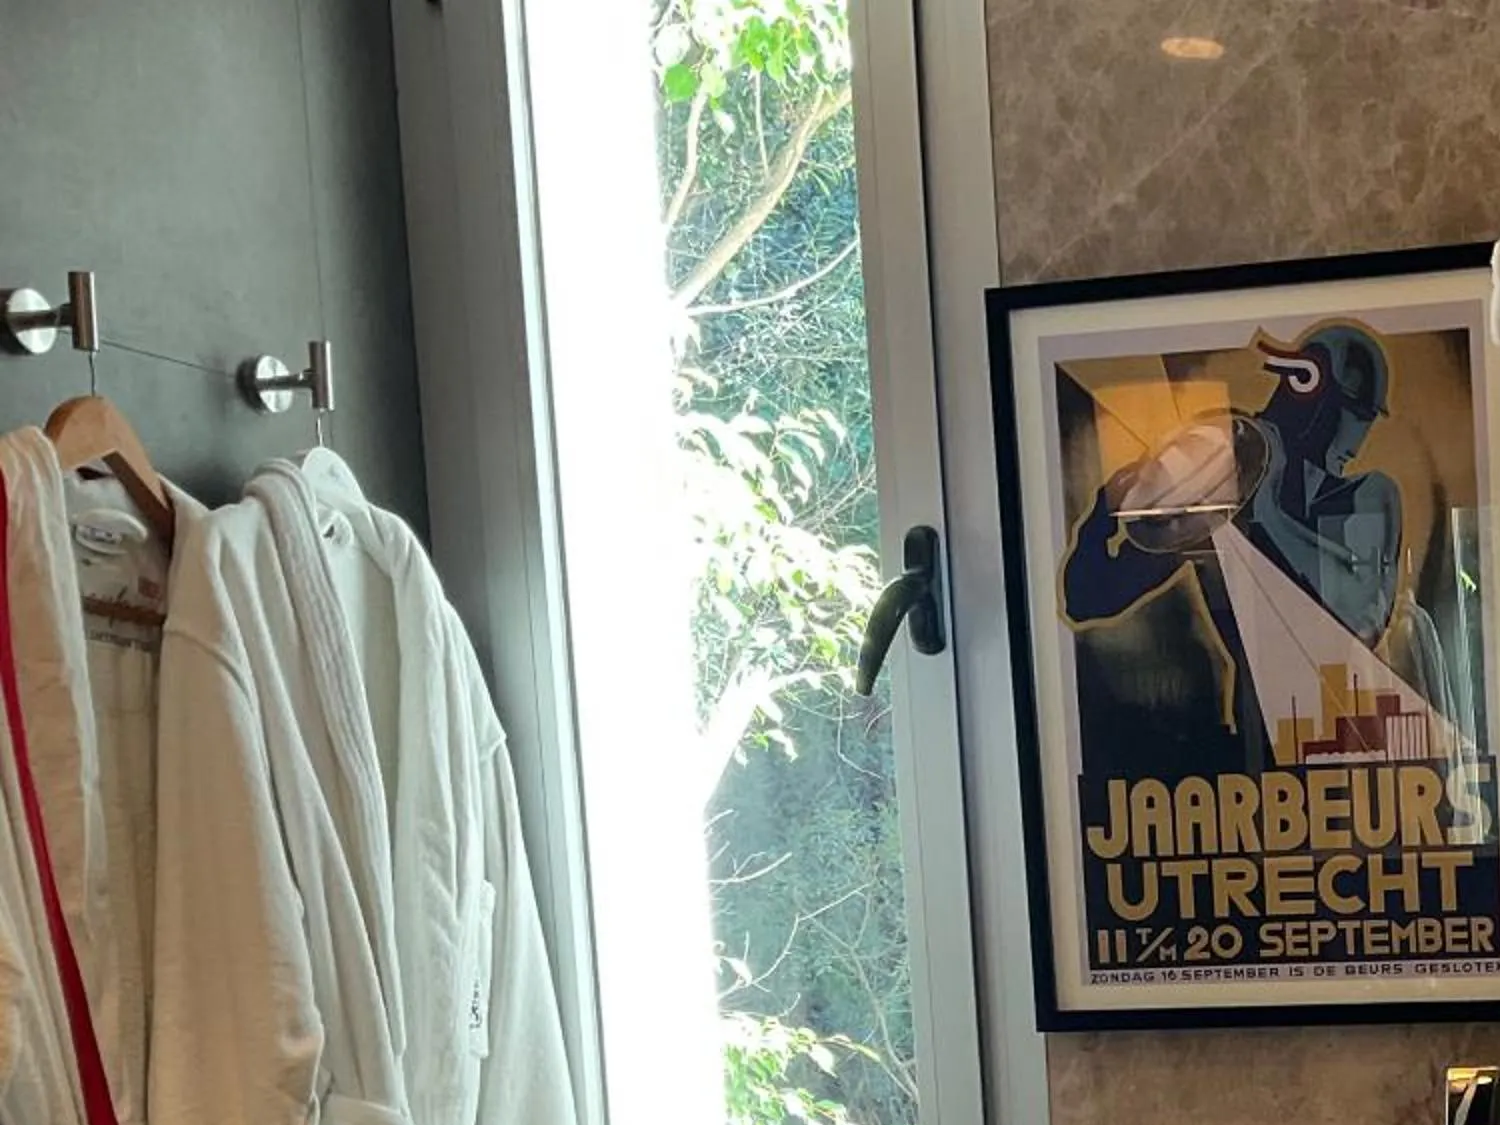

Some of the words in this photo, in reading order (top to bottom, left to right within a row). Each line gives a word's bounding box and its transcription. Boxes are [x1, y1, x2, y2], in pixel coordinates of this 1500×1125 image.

[1087, 763, 1493, 859] JAARBEURS
[1106, 851, 1474, 921] UTRECHT
[1183, 924, 1243, 962] 20
[1259, 916, 1495, 958] SEPTEMBER
[1090, 971, 1155, 985] ZONDAG
[1180, 967, 1279, 981] SEPTEMBER
[1288, 966, 1304, 977] IS
[1313, 965, 1337, 977] DE
[1345, 963, 1403, 976] BEURS
